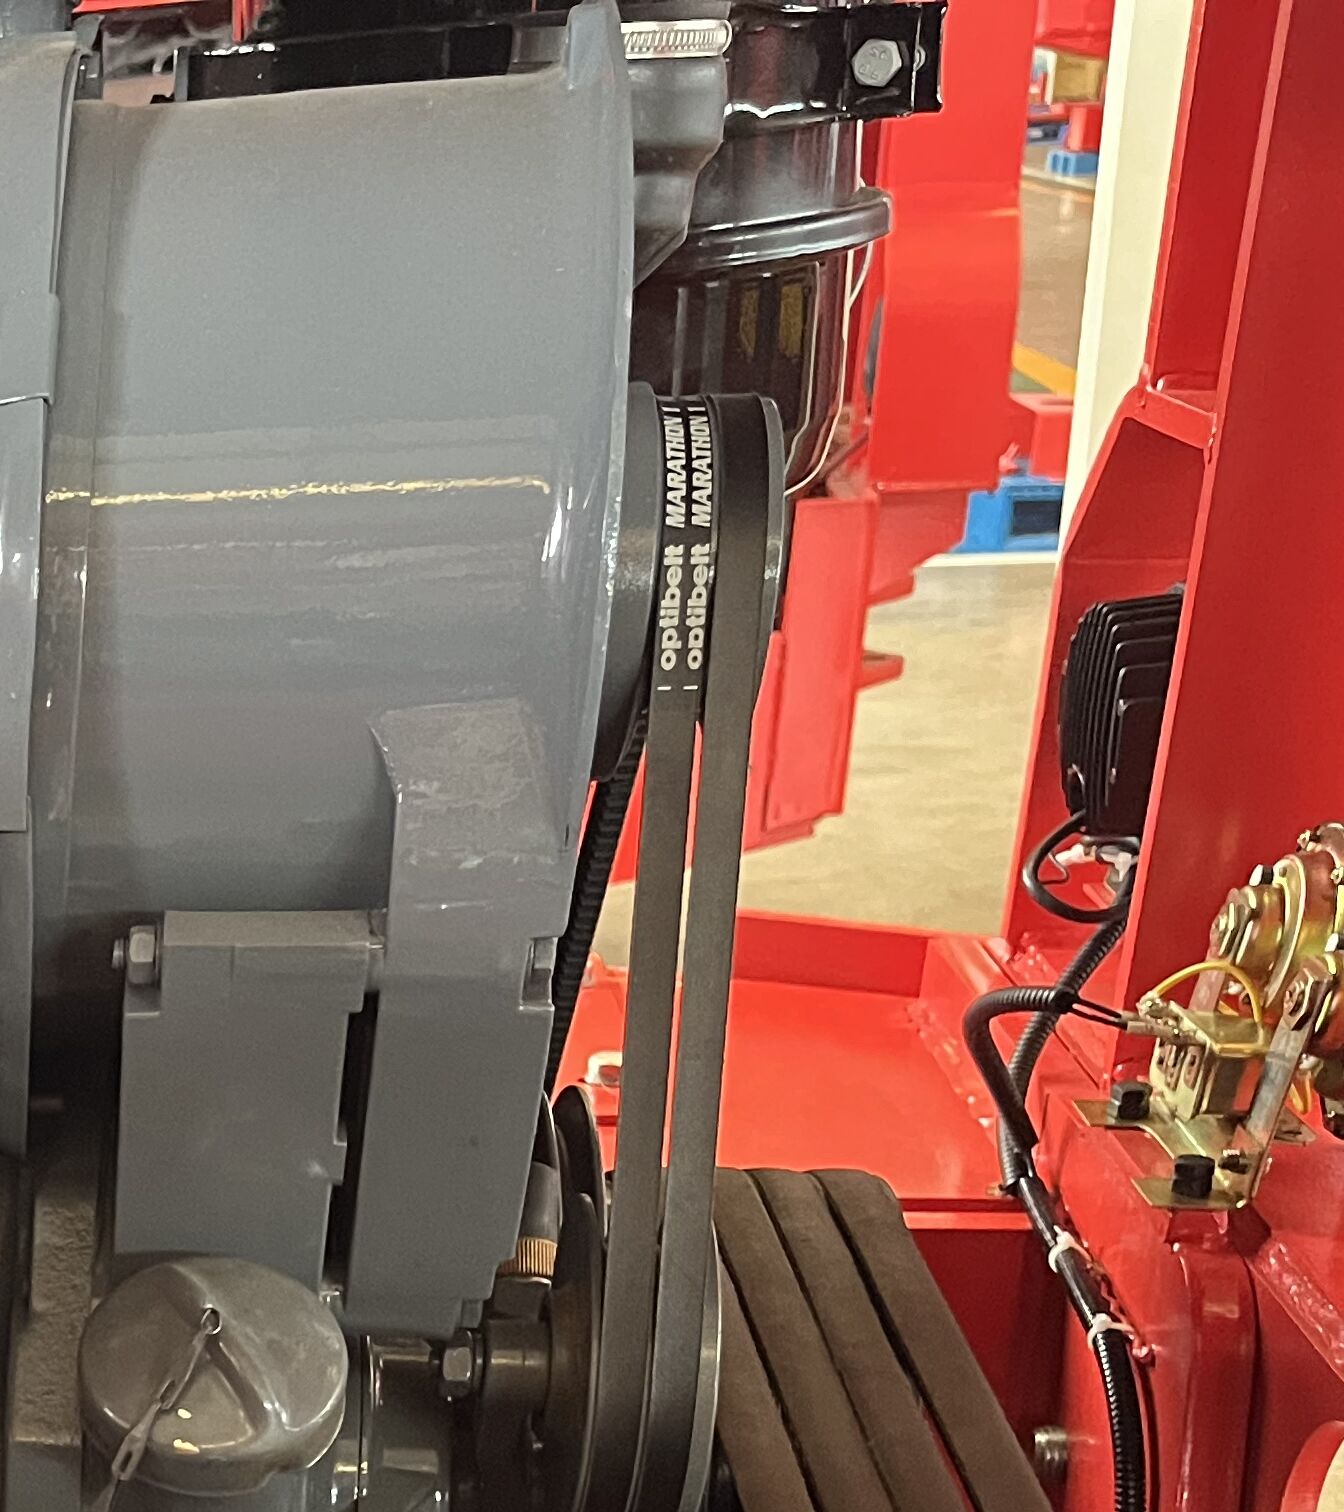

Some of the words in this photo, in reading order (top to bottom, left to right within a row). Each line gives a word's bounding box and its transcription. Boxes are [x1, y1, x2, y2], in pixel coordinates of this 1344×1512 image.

[664, 415, 687, 529] MARATHON
[688, 415, 713, 528] MARATHON
[658, 543, 685, 671] optibelt
[686, 543, 711, 670] optibelt
